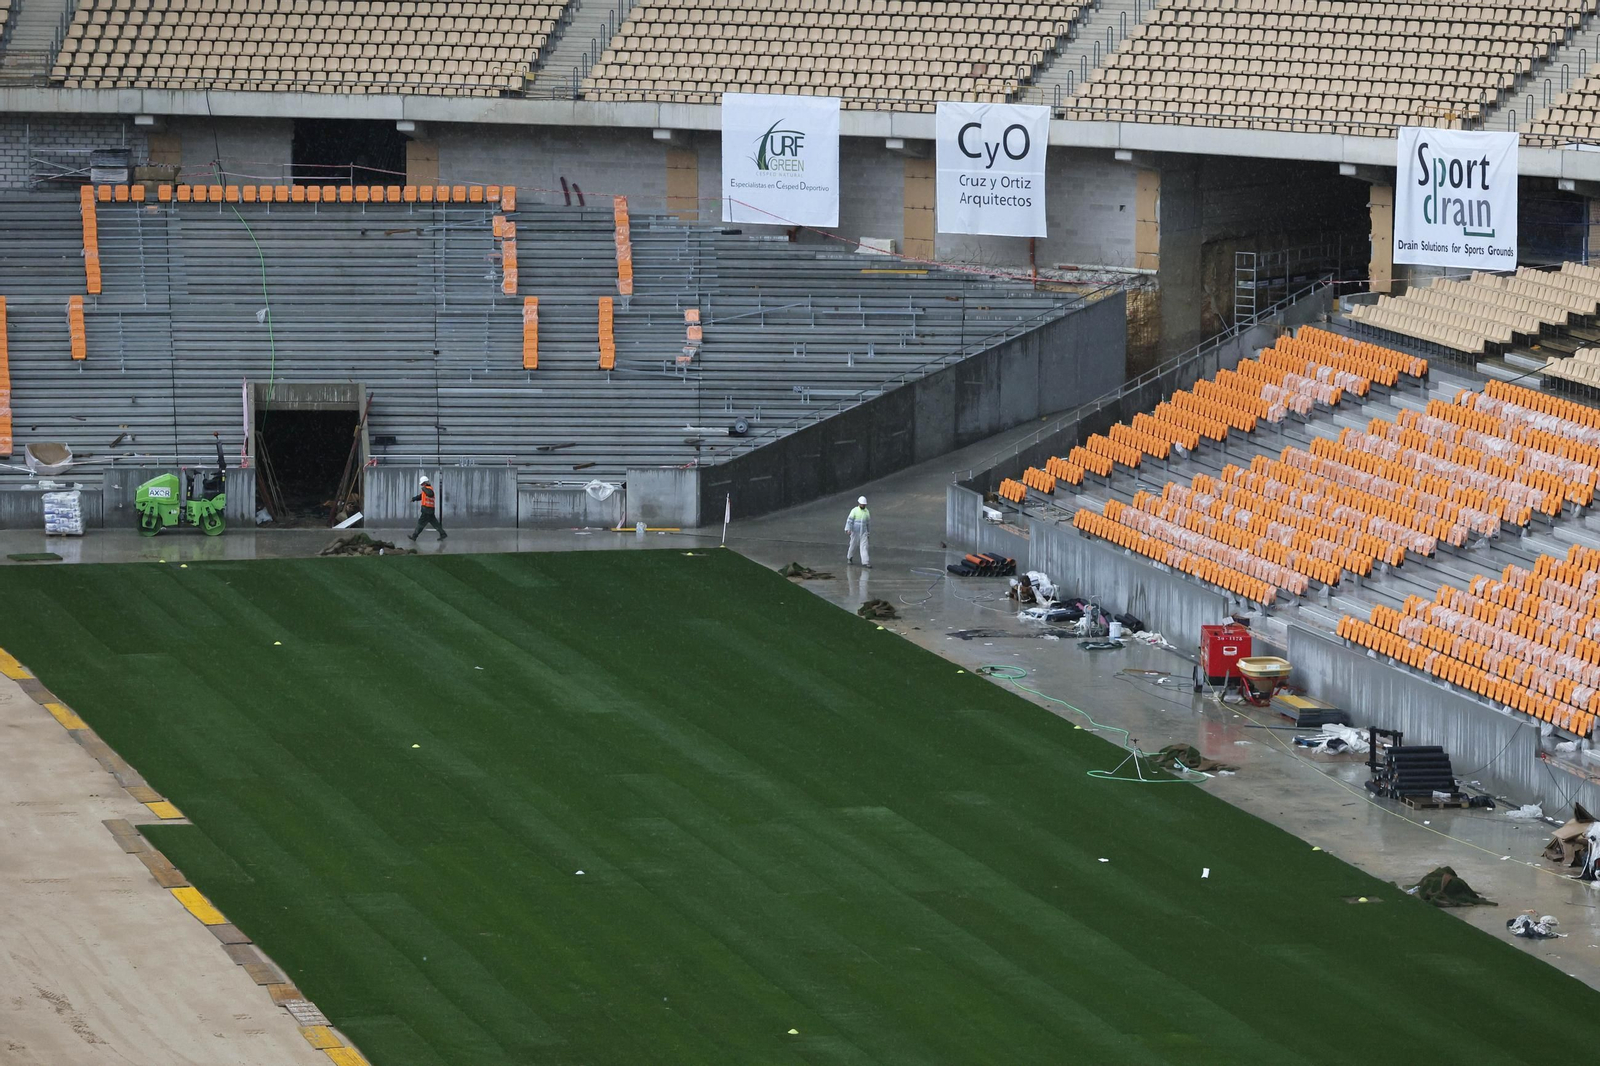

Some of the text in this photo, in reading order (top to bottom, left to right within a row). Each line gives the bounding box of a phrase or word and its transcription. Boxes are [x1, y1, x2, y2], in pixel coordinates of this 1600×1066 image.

[957, 122, 1030, 169] CyO
[770, 158, 804, 172] GREEN
[1417, 142, 1490, 192] Sport
[730, 178, 767, 189] Especialistas
[775, 180, 799, 191] Césped
[799, 181, 830, 192] Deportivo
[959, 174, 1032, 190] Cruz y Ortiz
[959, 192, 1032, 208] Arquitectos
[1423, 193, 1492, 228] drain
[1398, 240, 1514, 257] Drain Solutions for Sports Grounds
[149, 489, 170, 497] AXOR
